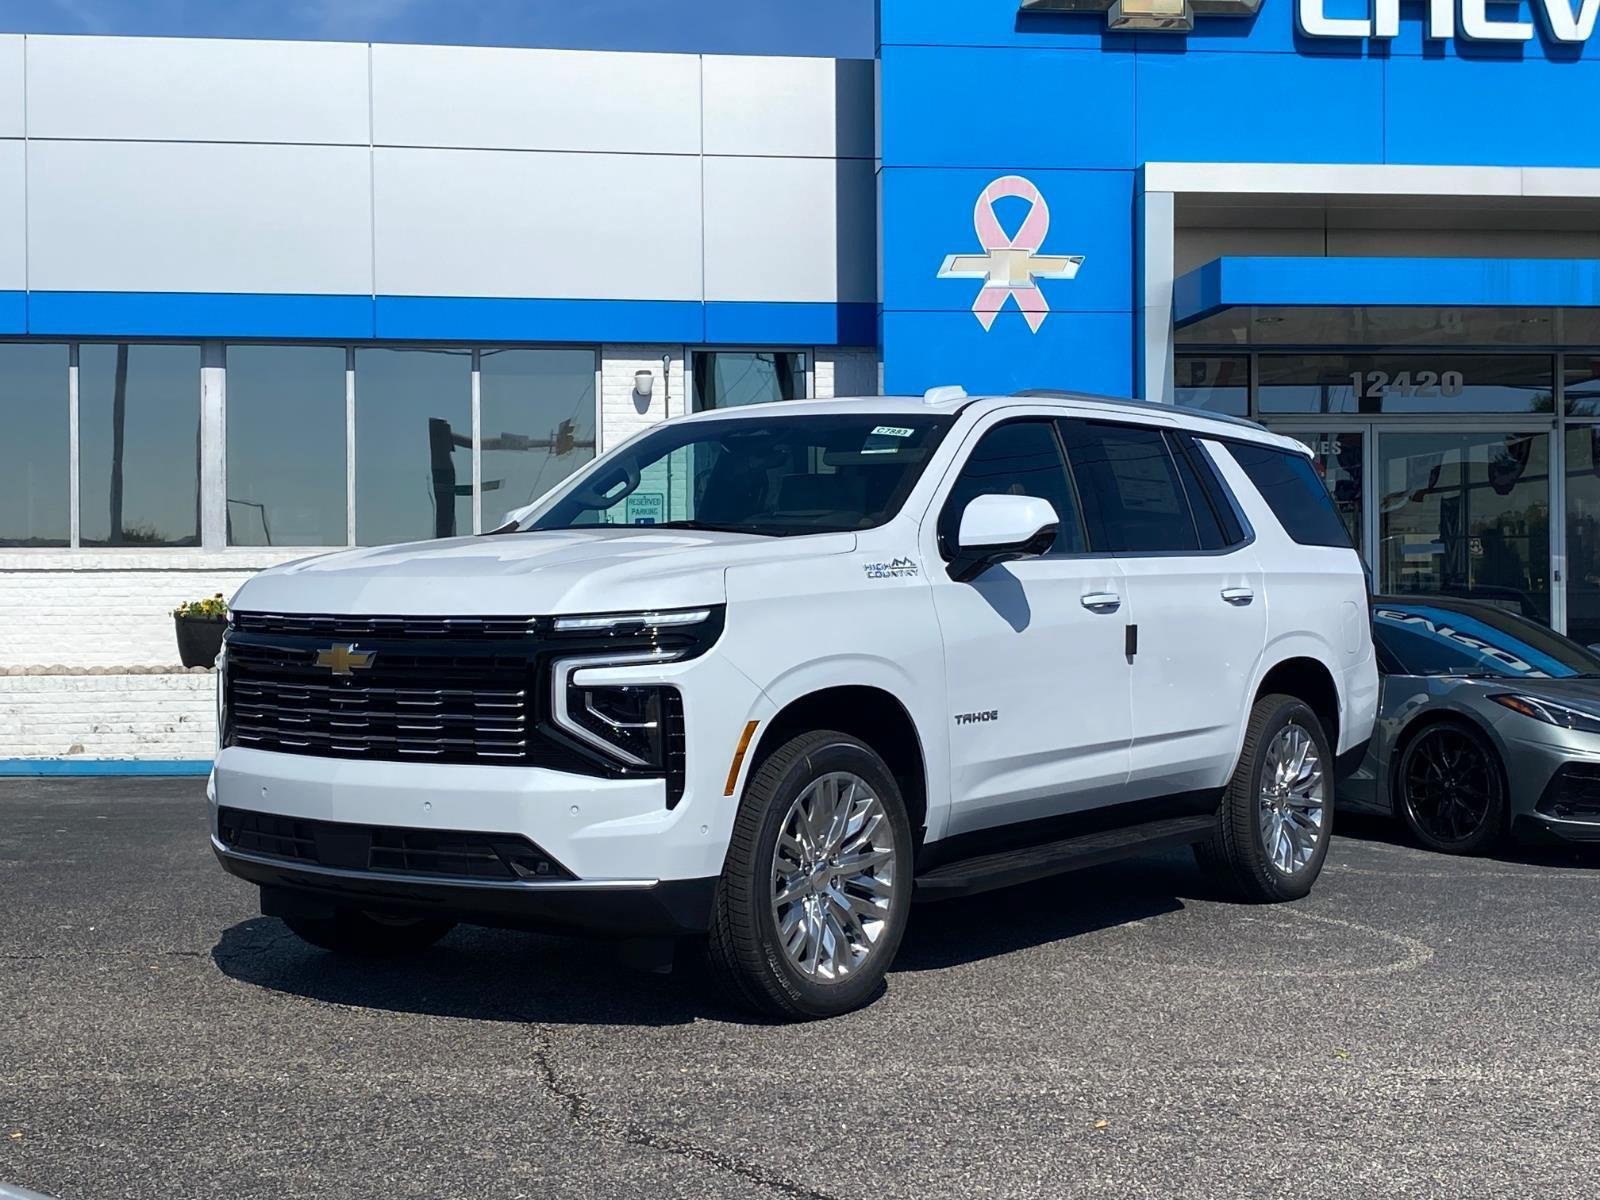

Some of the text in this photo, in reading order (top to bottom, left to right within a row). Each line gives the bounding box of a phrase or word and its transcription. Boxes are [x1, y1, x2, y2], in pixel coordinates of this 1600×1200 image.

[1349, 371, 1463, 398] 12420
[1311, 441, 1341, 455] LES
[629, 498, 661, 506] RESERVED
[631, 508, 658, 516] PARKING
[863, 563, 891, 571] HIGH
[867, 569, 918, 578] COUNTRY
[954, 709, 998, 726] TAHOE
